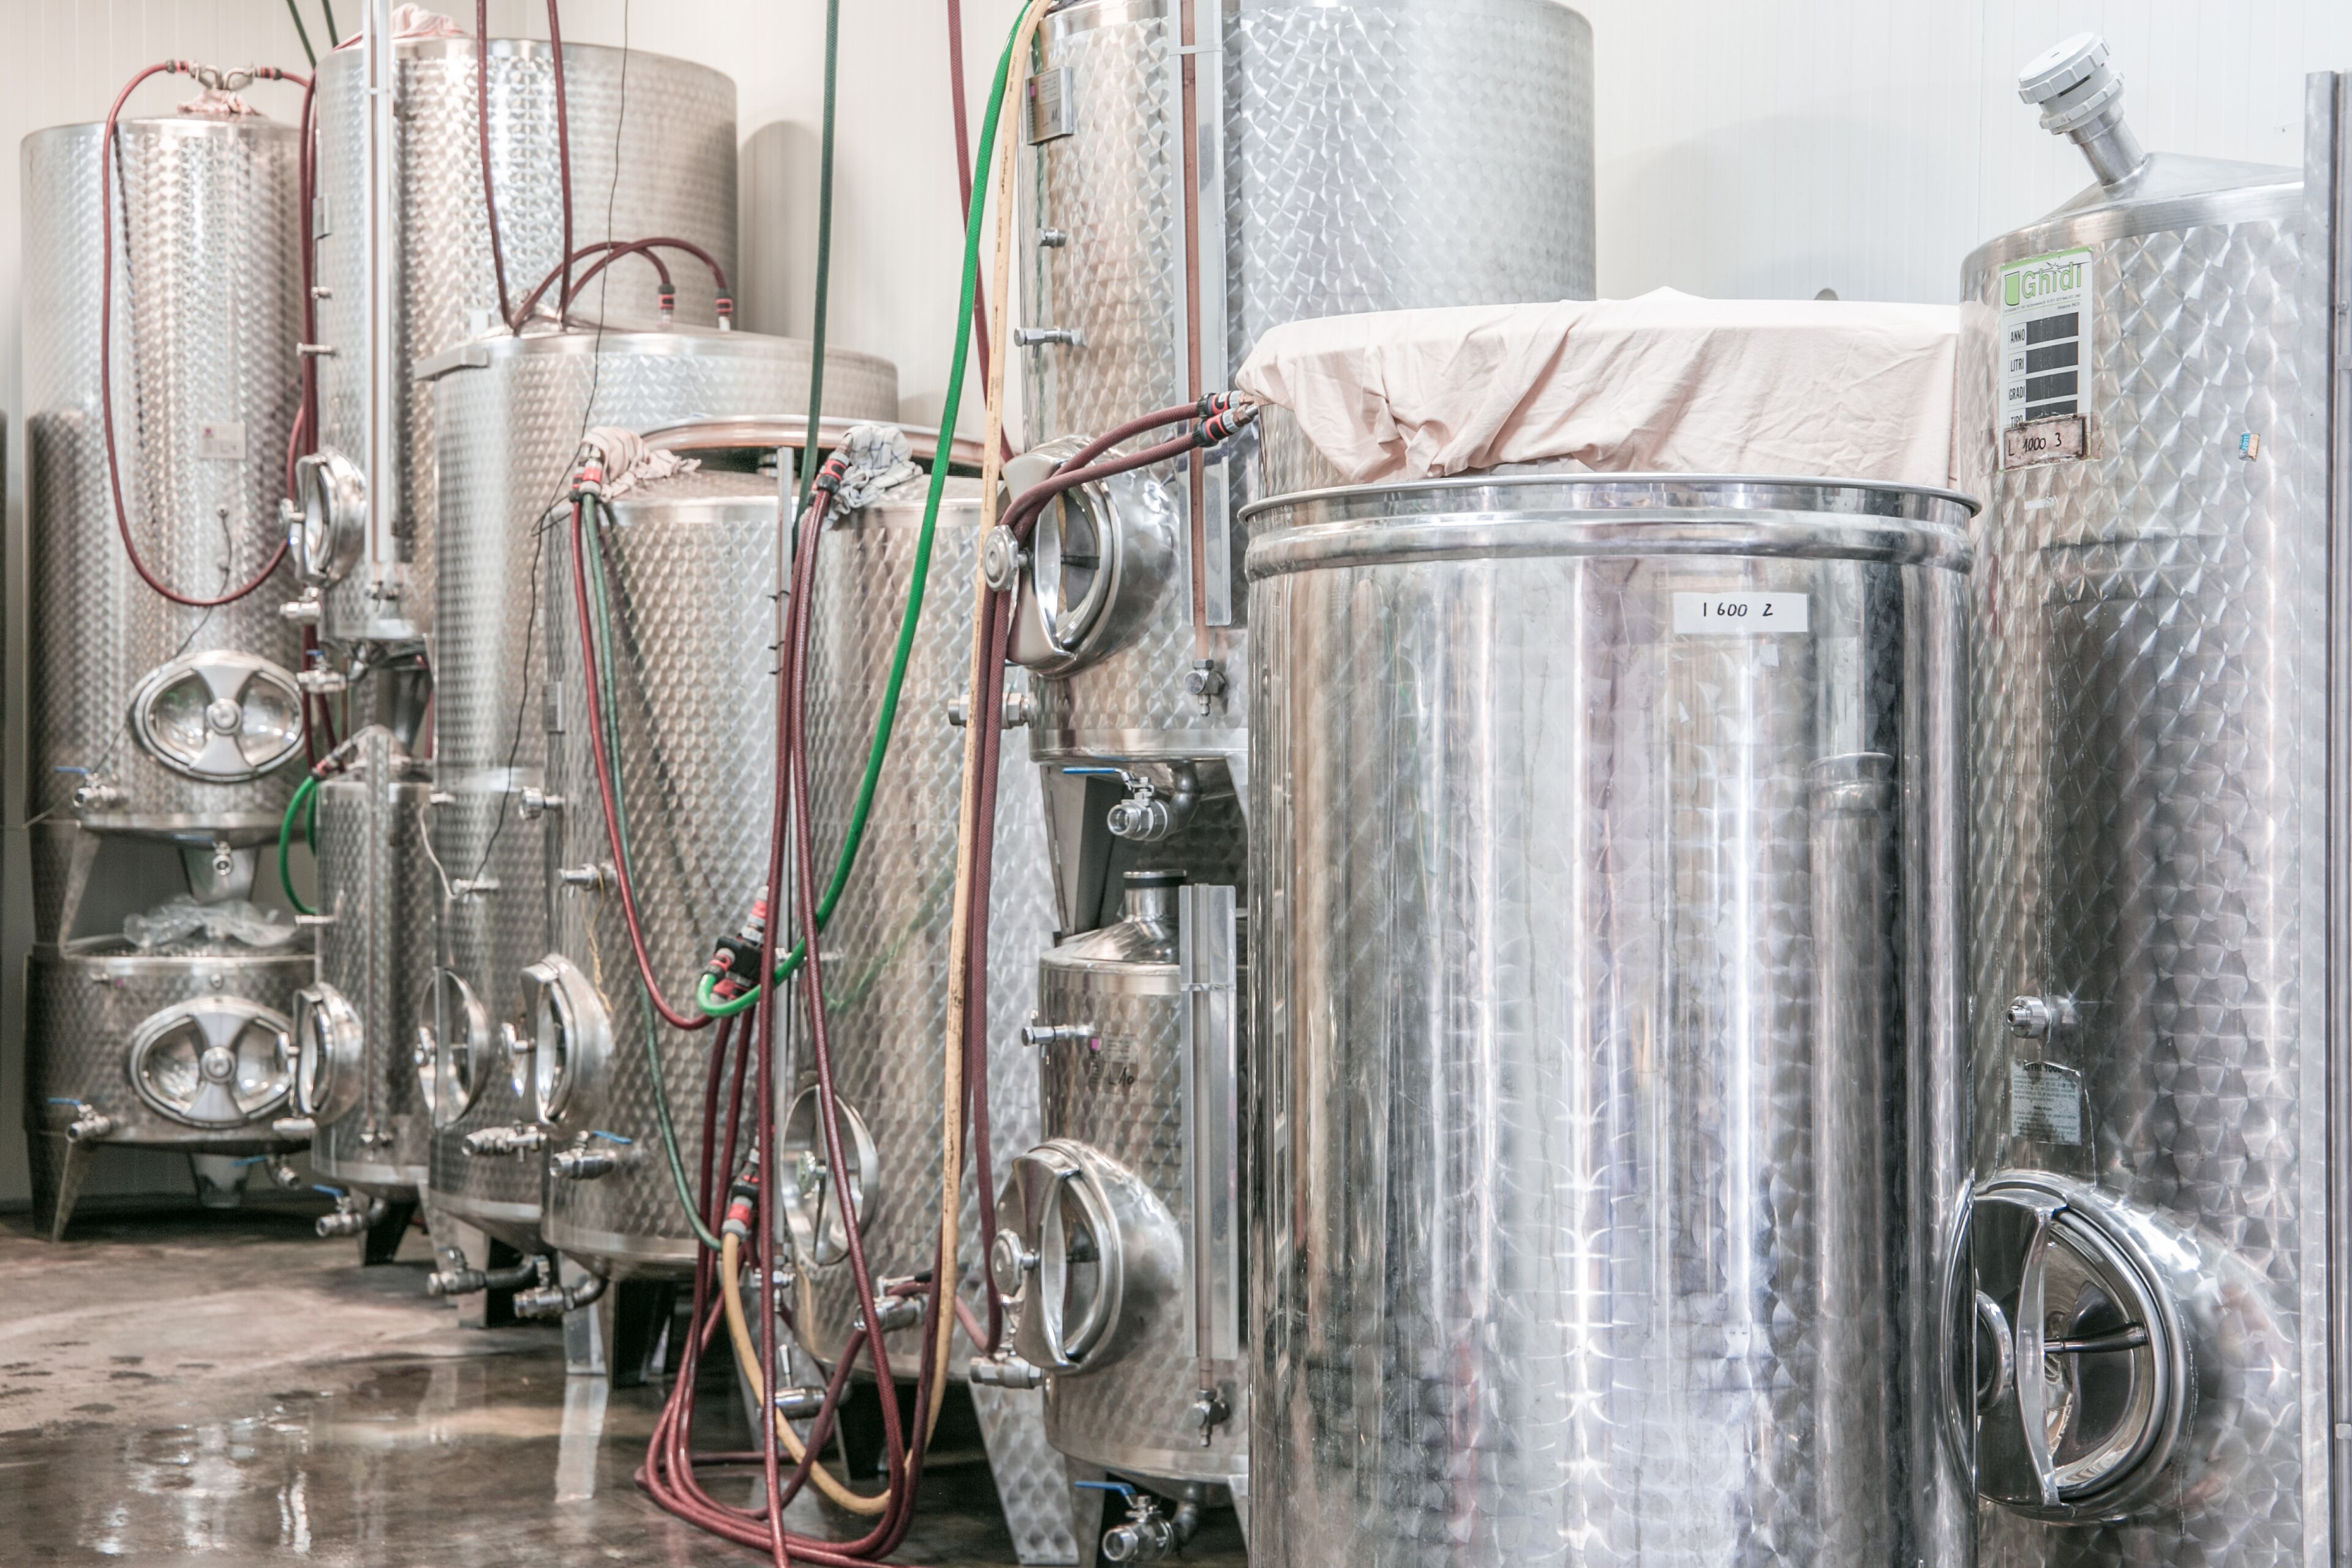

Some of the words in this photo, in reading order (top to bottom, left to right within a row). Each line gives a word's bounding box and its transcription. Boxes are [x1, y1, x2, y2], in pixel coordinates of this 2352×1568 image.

[2021, 262, 2081, 299] Ghidi
[2010, 328, 2026, 344] ANNO
[2010, 357, 2024, 372] LITRI
[2009, 385, 2025, 401] GRADI
[2008, 440, 2015, 456] L
[2022, 437, 2046, 453] 1000
[2054, 432, 2062, 447] 3
